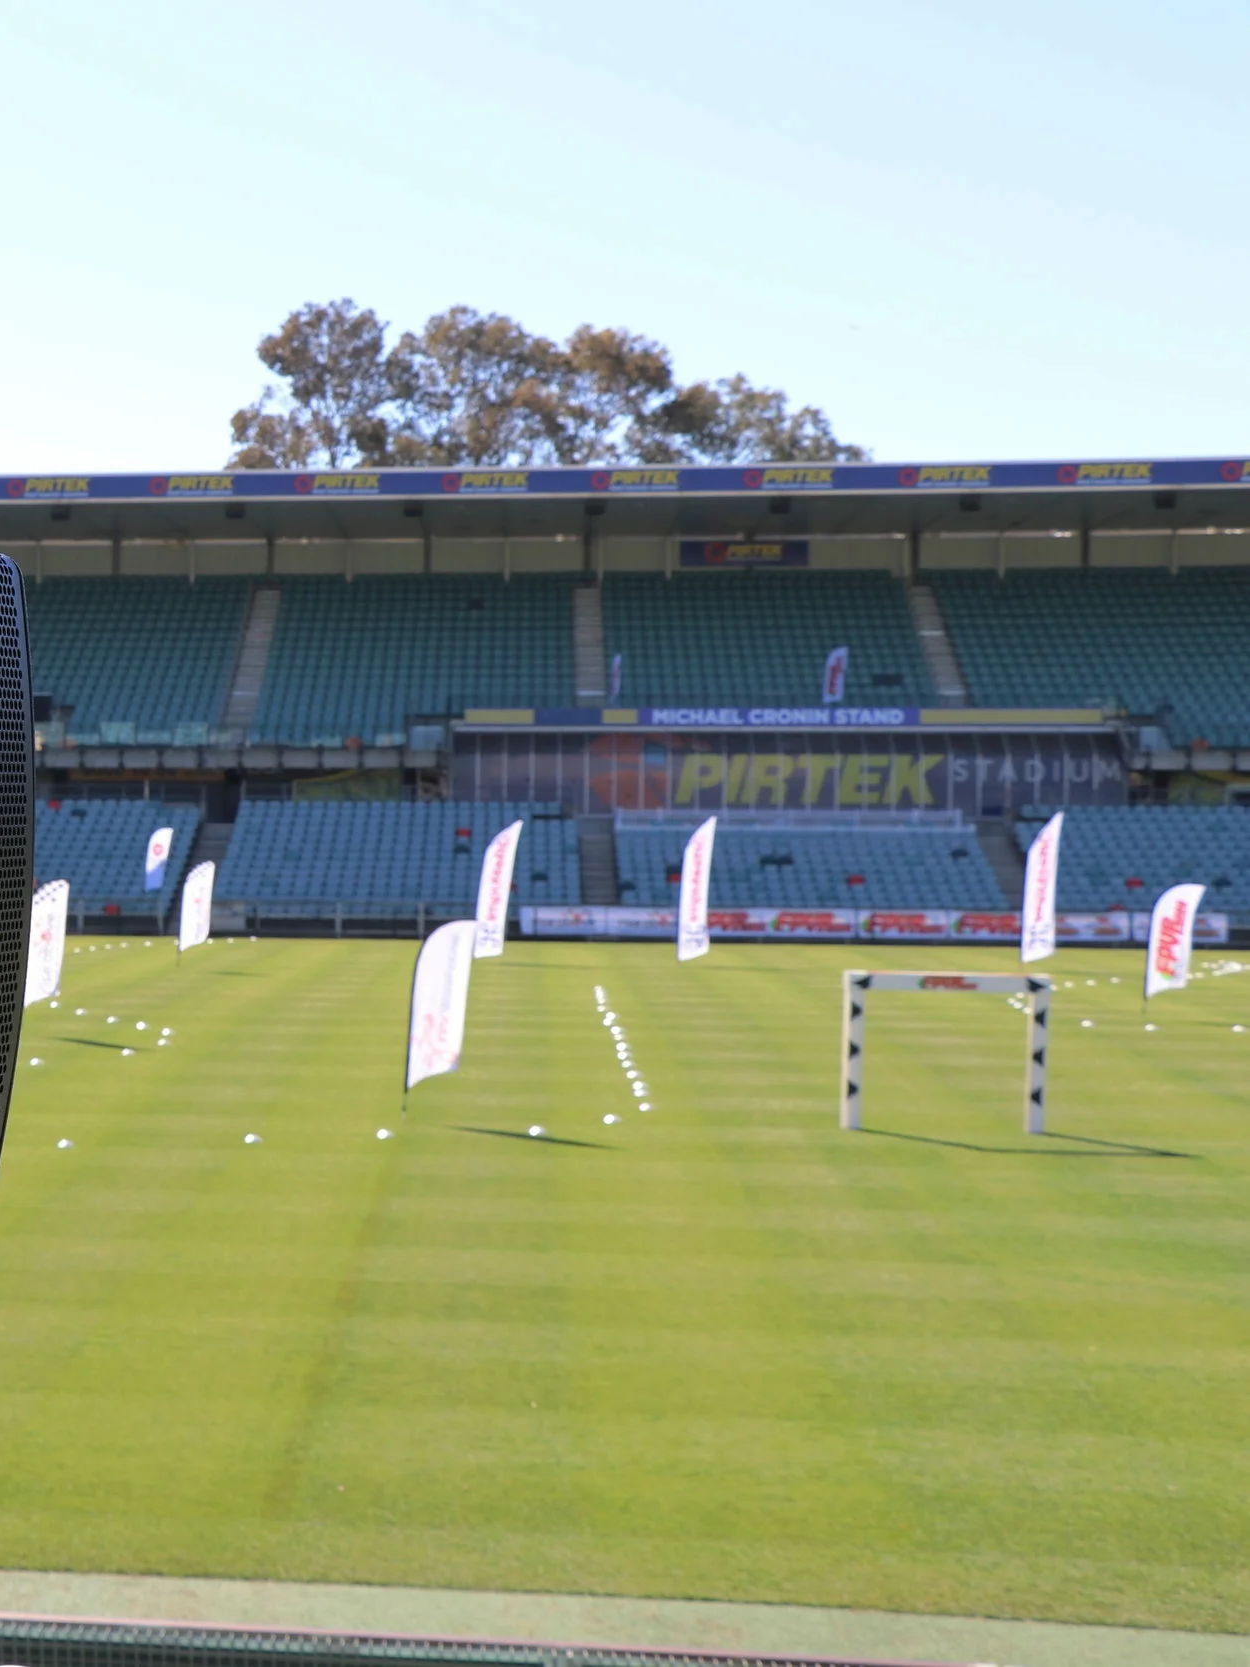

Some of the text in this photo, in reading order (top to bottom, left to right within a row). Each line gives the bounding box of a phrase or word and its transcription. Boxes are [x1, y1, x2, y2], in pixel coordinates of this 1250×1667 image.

[610, 469, 679, 485] PIRTEK
[762, 468, 833, 483] PIRTEK
[917, 466, 990, 481] PIRTEK
[1077, 463, 1152, 478] PIRTEK
[25, 477, 89, 492] PIRTEK
[167, 475, 234, 490] PIRTEK
[313, 473, 381, 489] PIRTEK
[460, 471, 528, 487] PIRTEK
[652, 709, 905, 725] MICHAEL CRONIN STAND
[675, 752, 1122, 805] PIRTEK STADIUM
